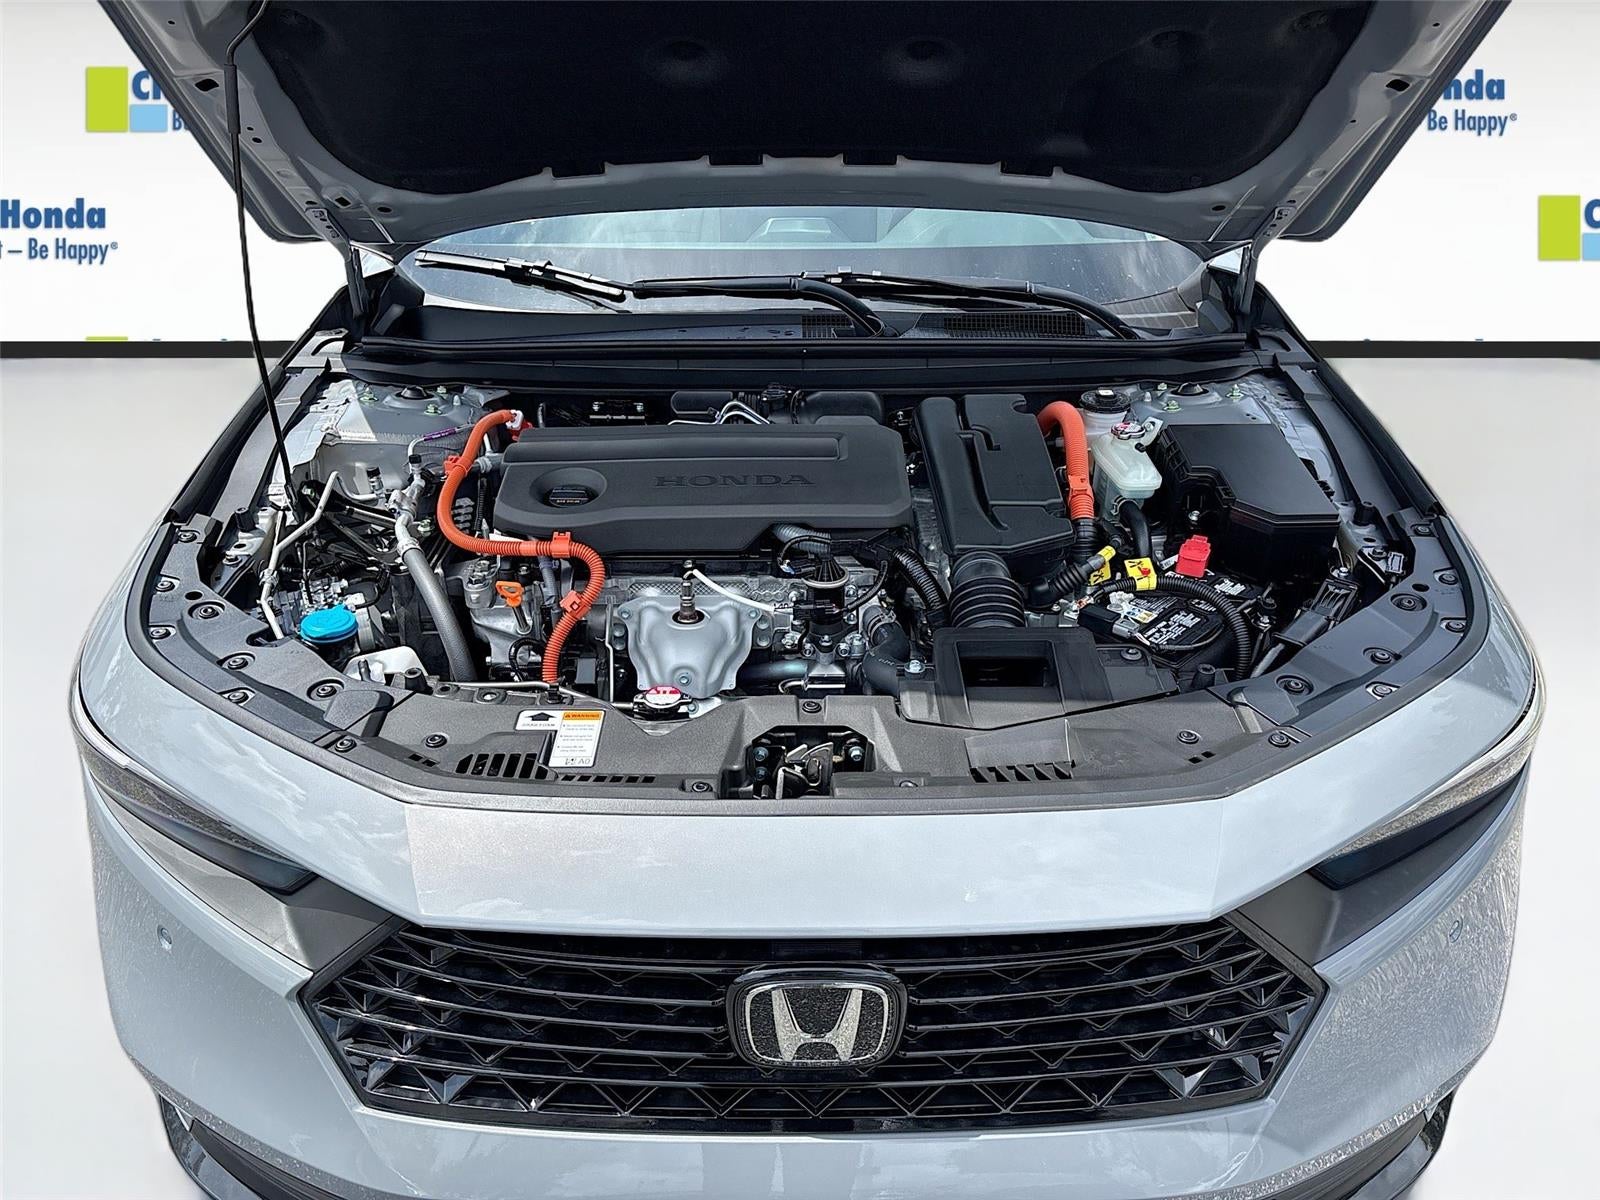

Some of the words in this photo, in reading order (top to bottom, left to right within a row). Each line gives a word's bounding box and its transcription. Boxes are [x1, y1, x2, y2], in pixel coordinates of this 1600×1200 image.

[1427, 109, 1448, 131] Be
[0, 198, 106, 229] Honda
[28, 237, 49, 260] Be
[656, 474, 815, 488] HONDA
